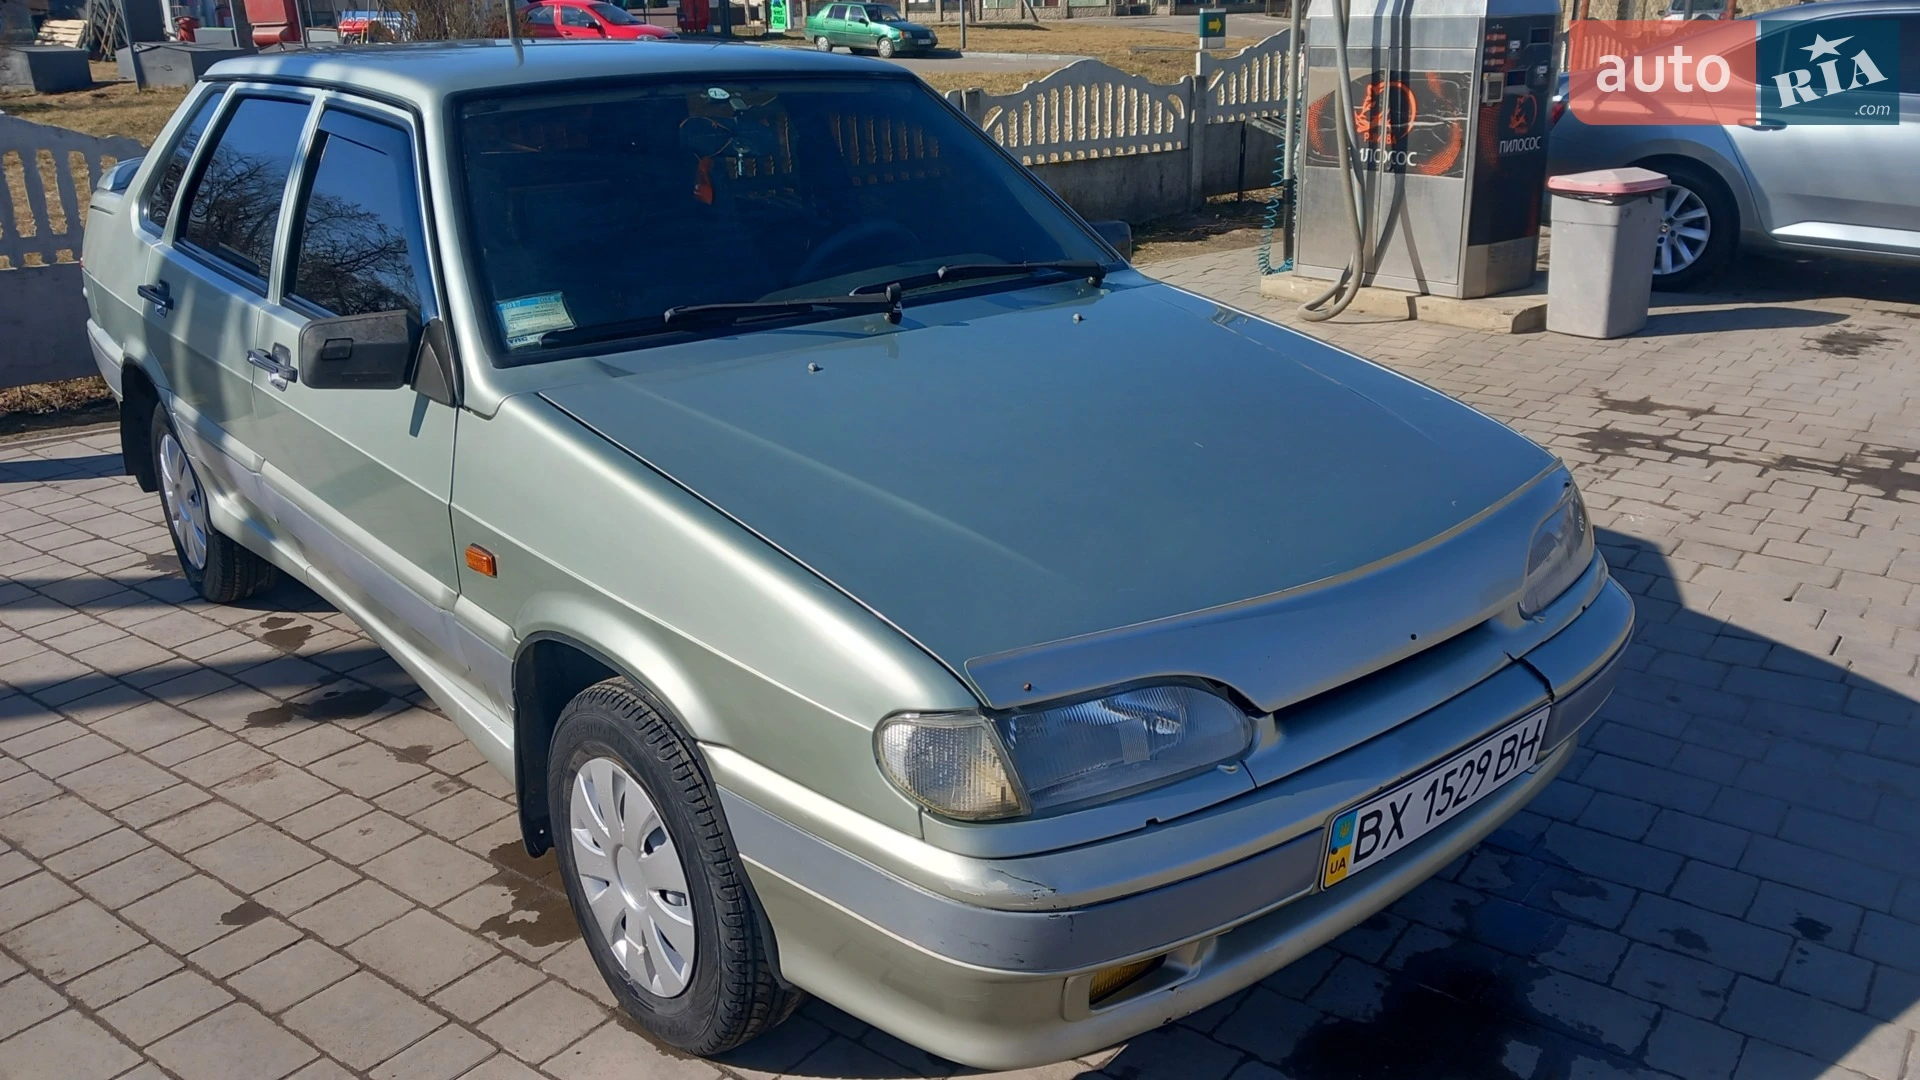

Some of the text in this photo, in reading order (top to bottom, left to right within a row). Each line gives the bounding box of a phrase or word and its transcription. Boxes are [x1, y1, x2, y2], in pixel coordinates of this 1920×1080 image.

[1499, 136, 1542, 154] ПИЛОСОС
[1353, 719, 1543, 864] BX 1529 BH
[1330, 857, 1347, 875] UA
